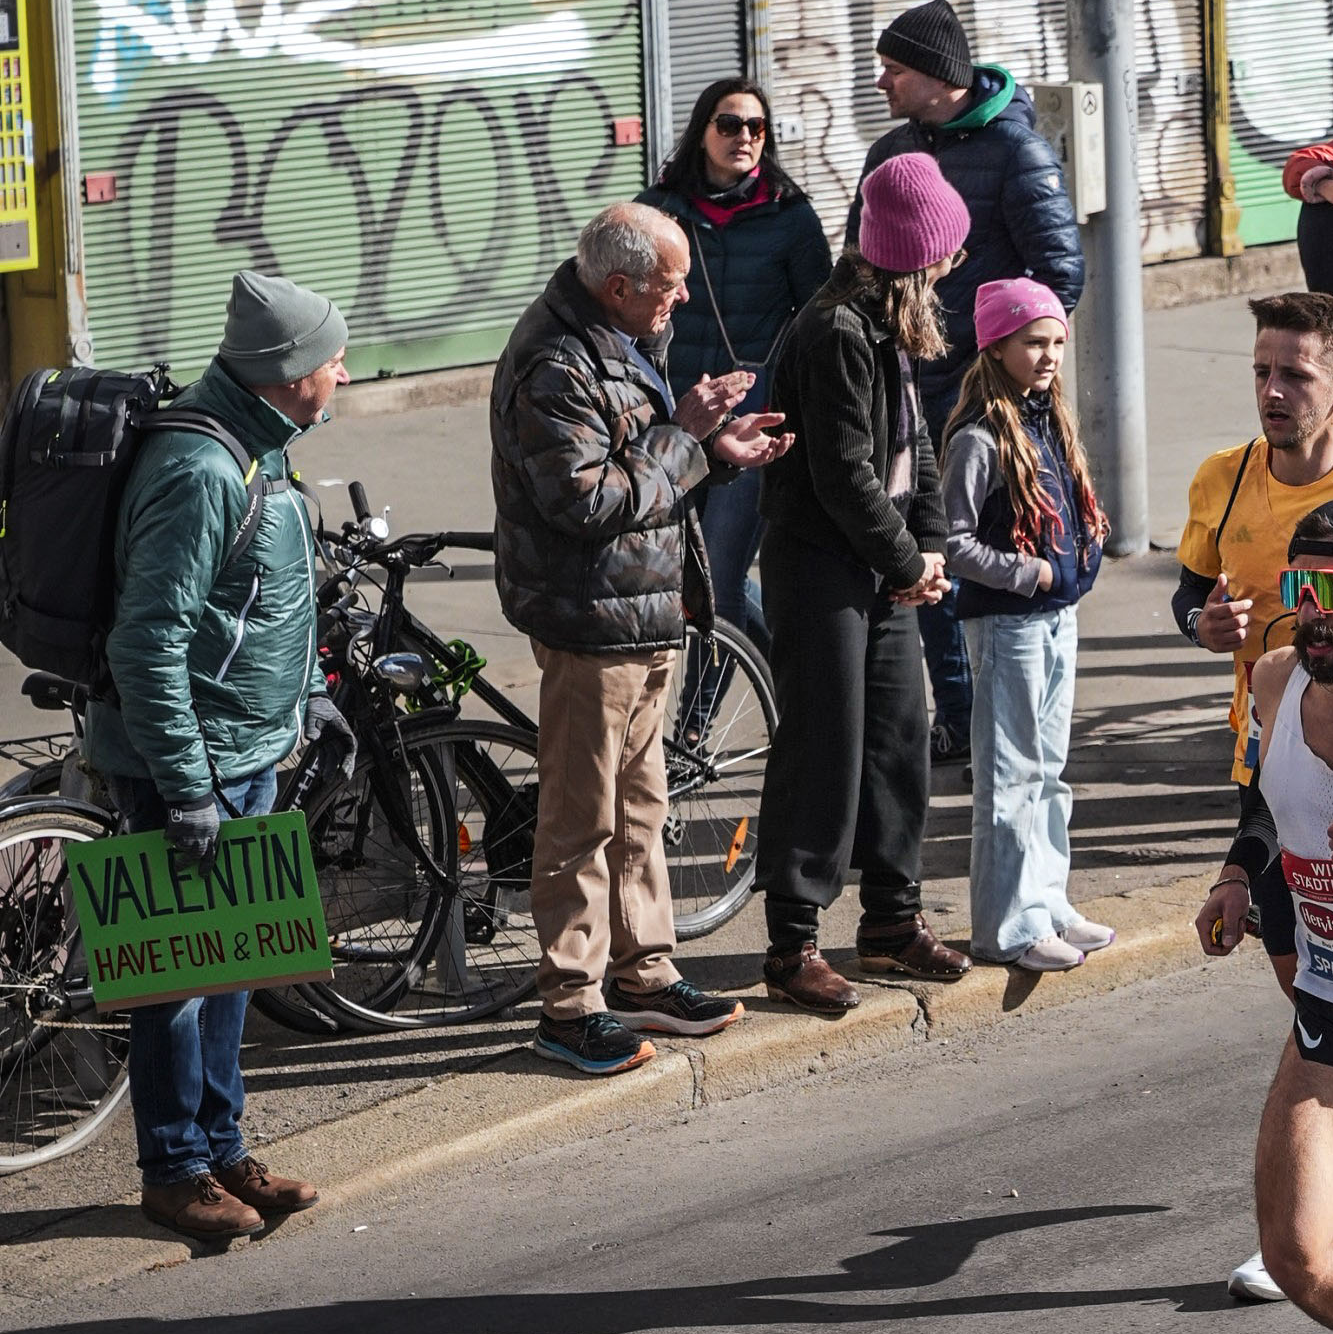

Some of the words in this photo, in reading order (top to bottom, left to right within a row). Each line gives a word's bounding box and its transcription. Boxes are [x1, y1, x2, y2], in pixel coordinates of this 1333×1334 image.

[76, 829, 305, 927] VALENTIN
[94, 938, 166, 982] HAVE
[168, 930, 226, 969] FUN
[233, 931, 250, 961] &
[255, 918, 318, 958] RUN
